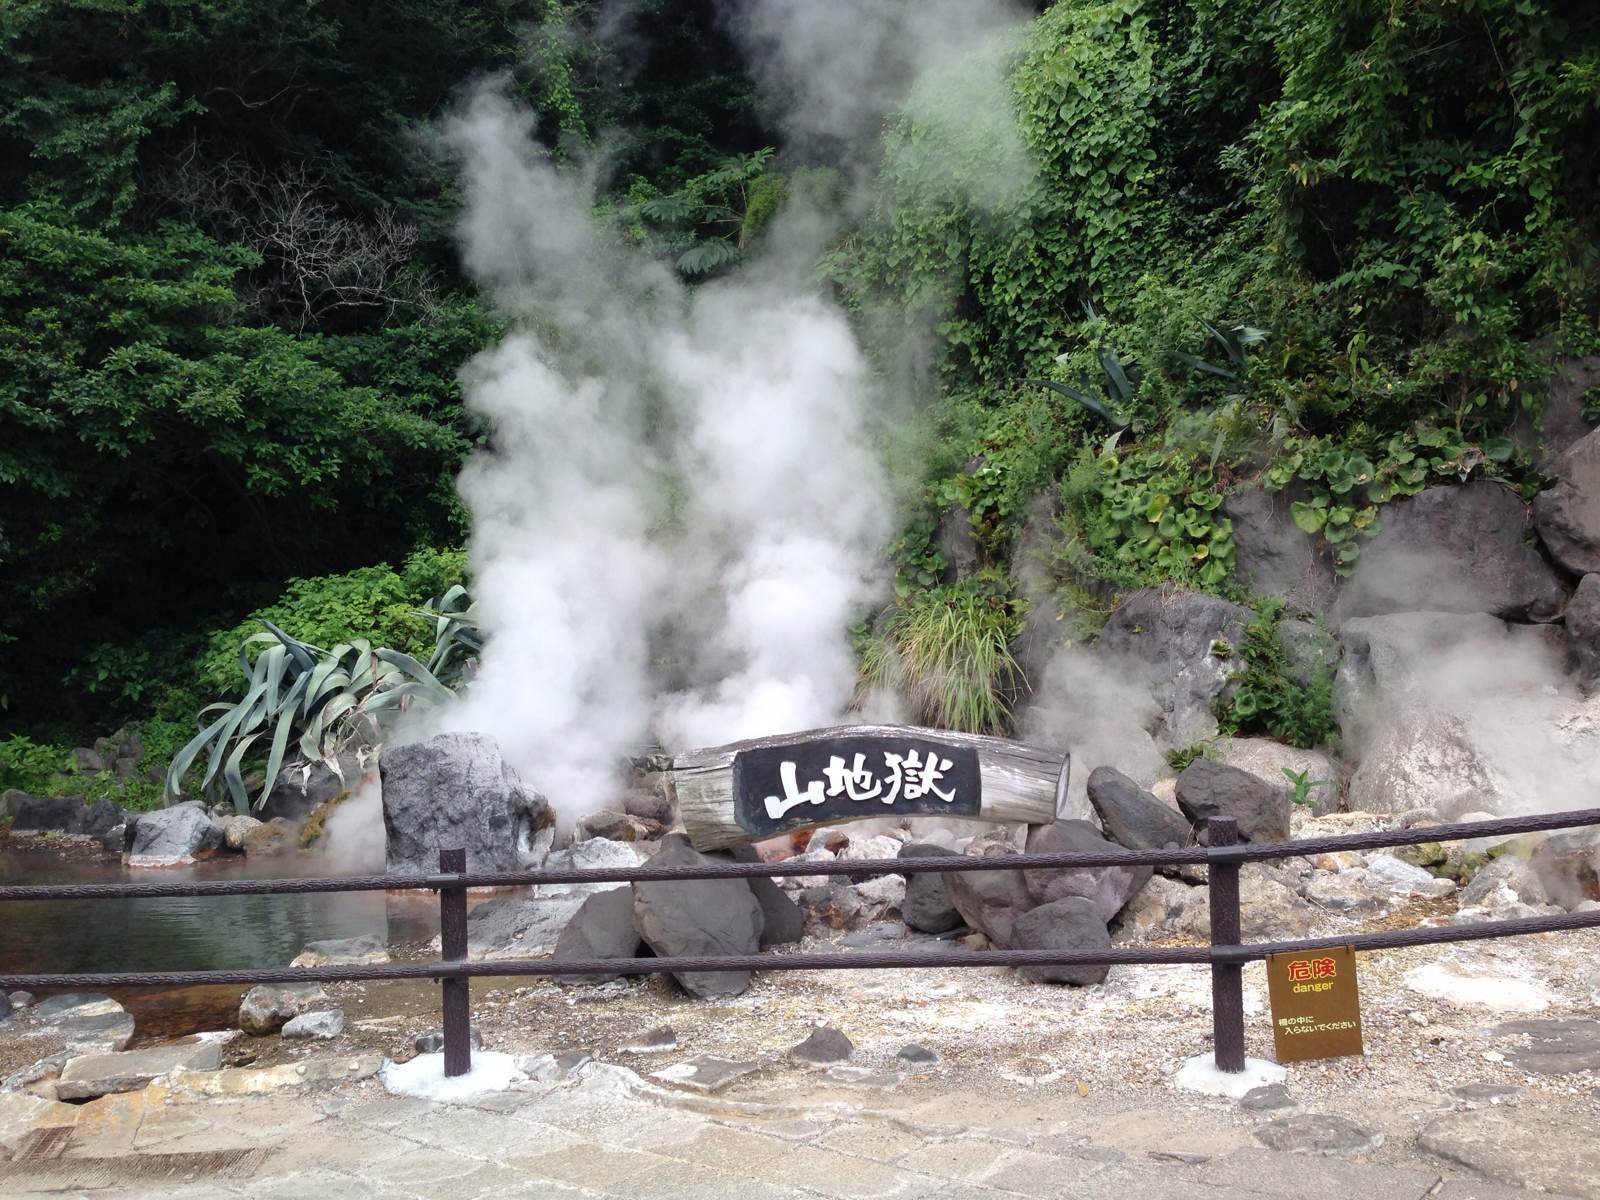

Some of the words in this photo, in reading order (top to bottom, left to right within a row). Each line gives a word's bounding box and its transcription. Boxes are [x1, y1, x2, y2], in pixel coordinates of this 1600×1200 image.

[763, 749, 956, 819] 山地獄
[1288, 957, 1336, 981] 危険
[1293, 982, 1334, 993] danger
[1284, 1021, 1356, 1035] 入らないでください
